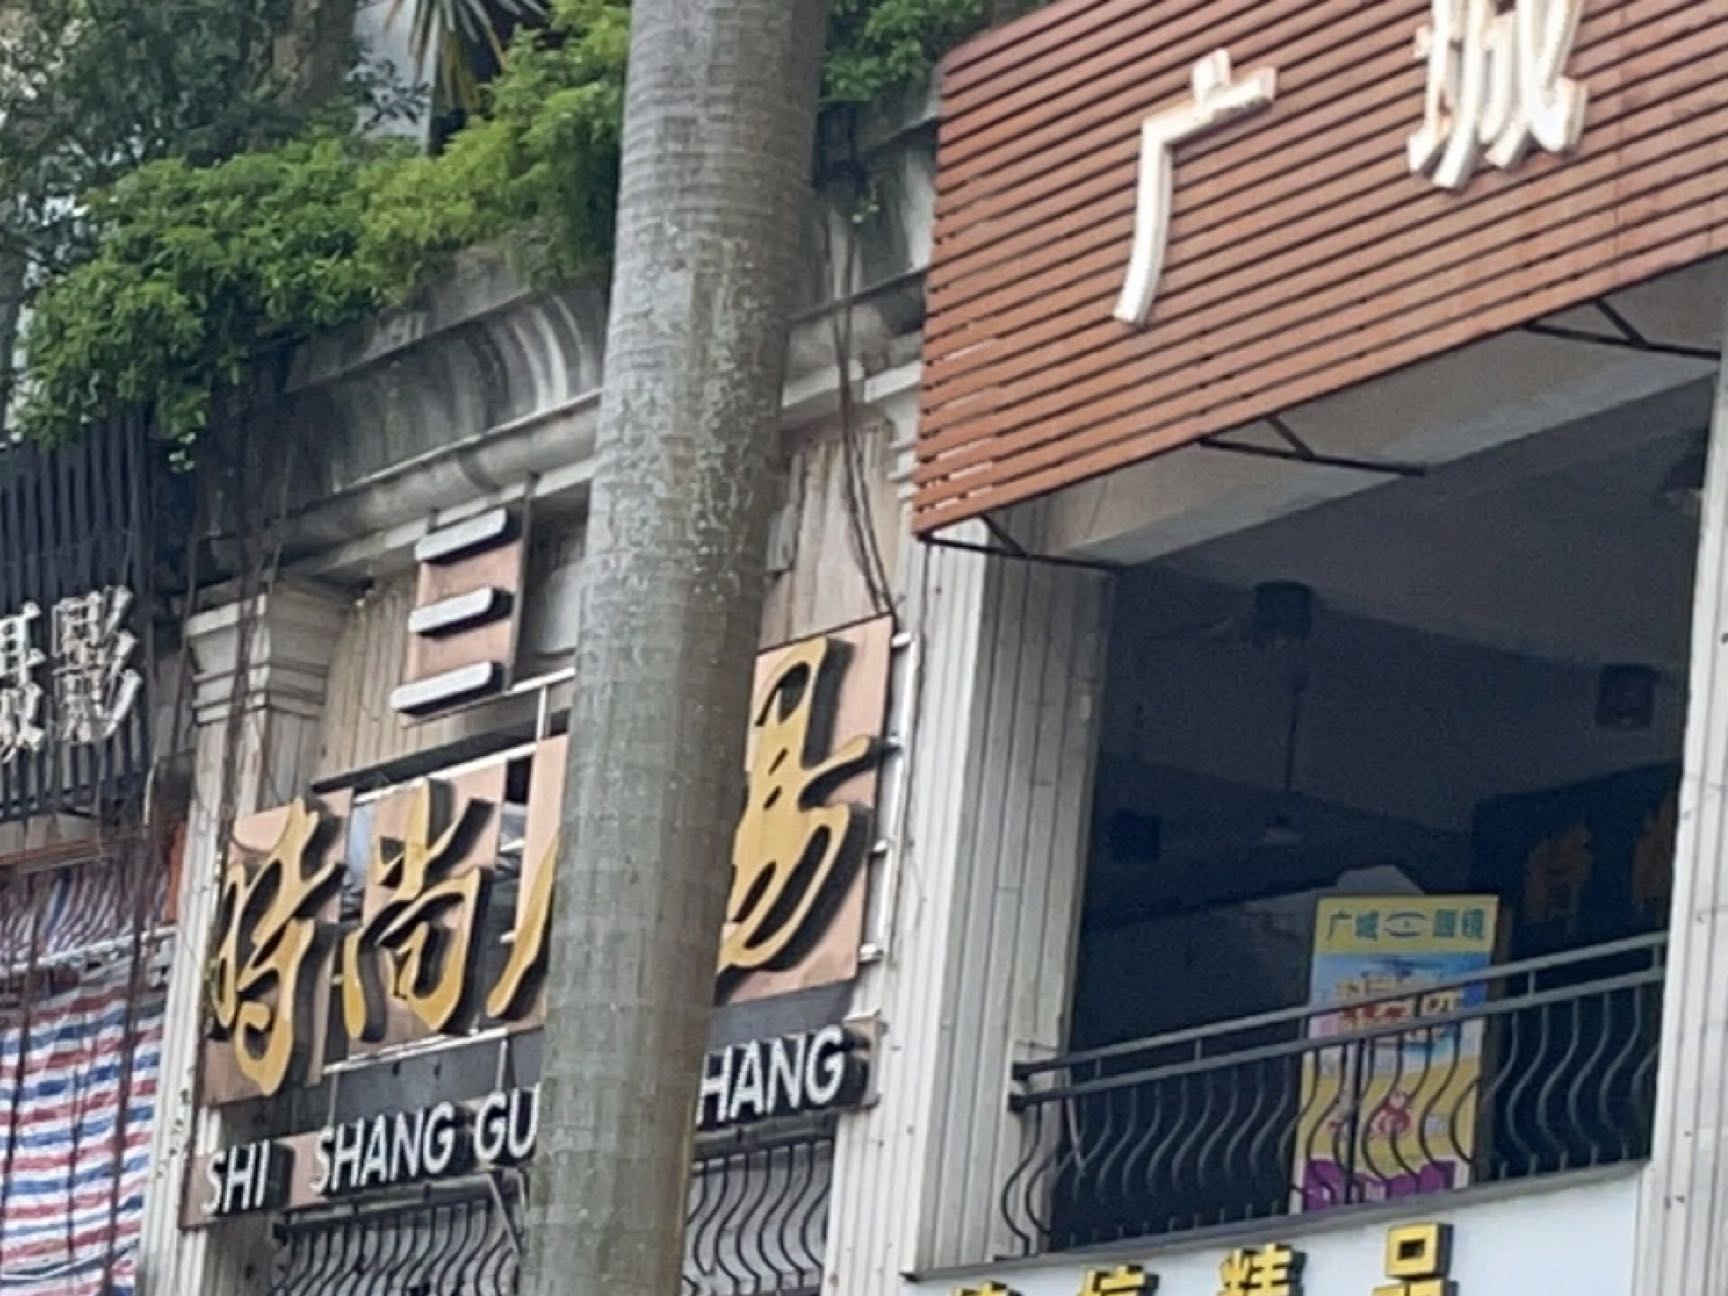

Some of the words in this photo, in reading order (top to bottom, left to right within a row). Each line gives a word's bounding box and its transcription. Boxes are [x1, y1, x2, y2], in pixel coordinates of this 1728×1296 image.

[201, 1139, 271, 1215] SHI
[311, 1102, 456, 1194] SHANG
[474, 1081, 540, 1164] GU
[696, 1026, 846, 1126] HANG
